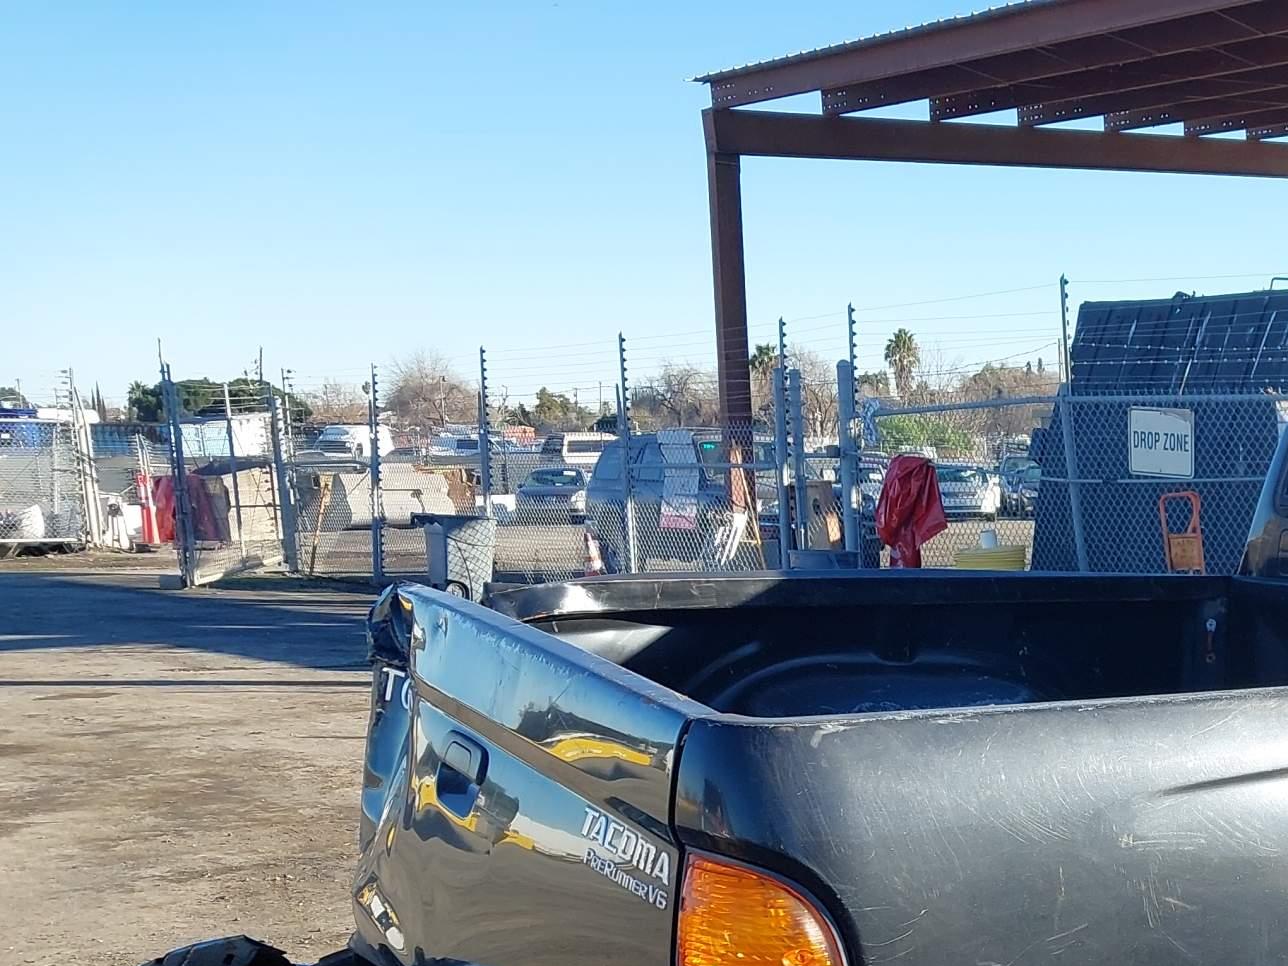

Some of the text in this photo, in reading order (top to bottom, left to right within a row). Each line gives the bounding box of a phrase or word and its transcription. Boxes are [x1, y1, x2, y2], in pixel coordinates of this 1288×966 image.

[1133, 430, 1190, 452] DROP ZONE
[581, 806, 669, 886] TACOMA
[648, 884, 668, 910] V6
